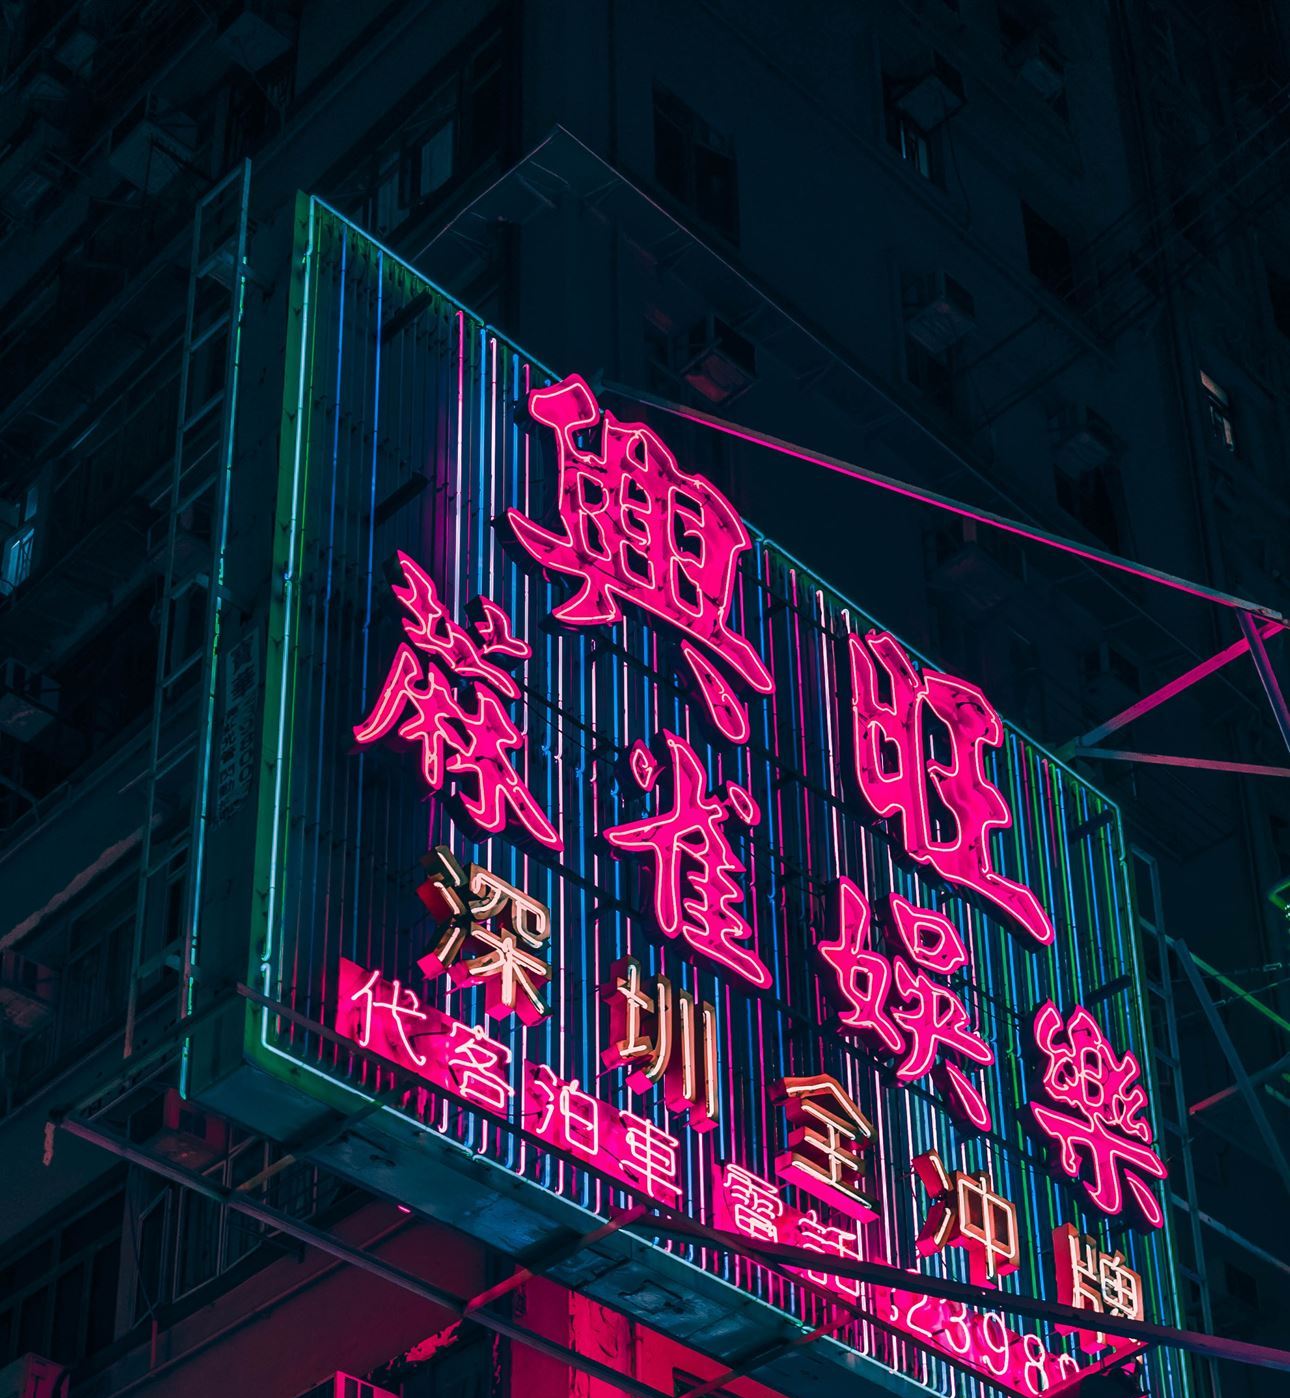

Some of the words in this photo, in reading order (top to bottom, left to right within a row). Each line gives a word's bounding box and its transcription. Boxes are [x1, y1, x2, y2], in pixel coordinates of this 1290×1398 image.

[507, 374, 1055, 946] 興旺
[352, 971, 682, 1197] 代客泊車
